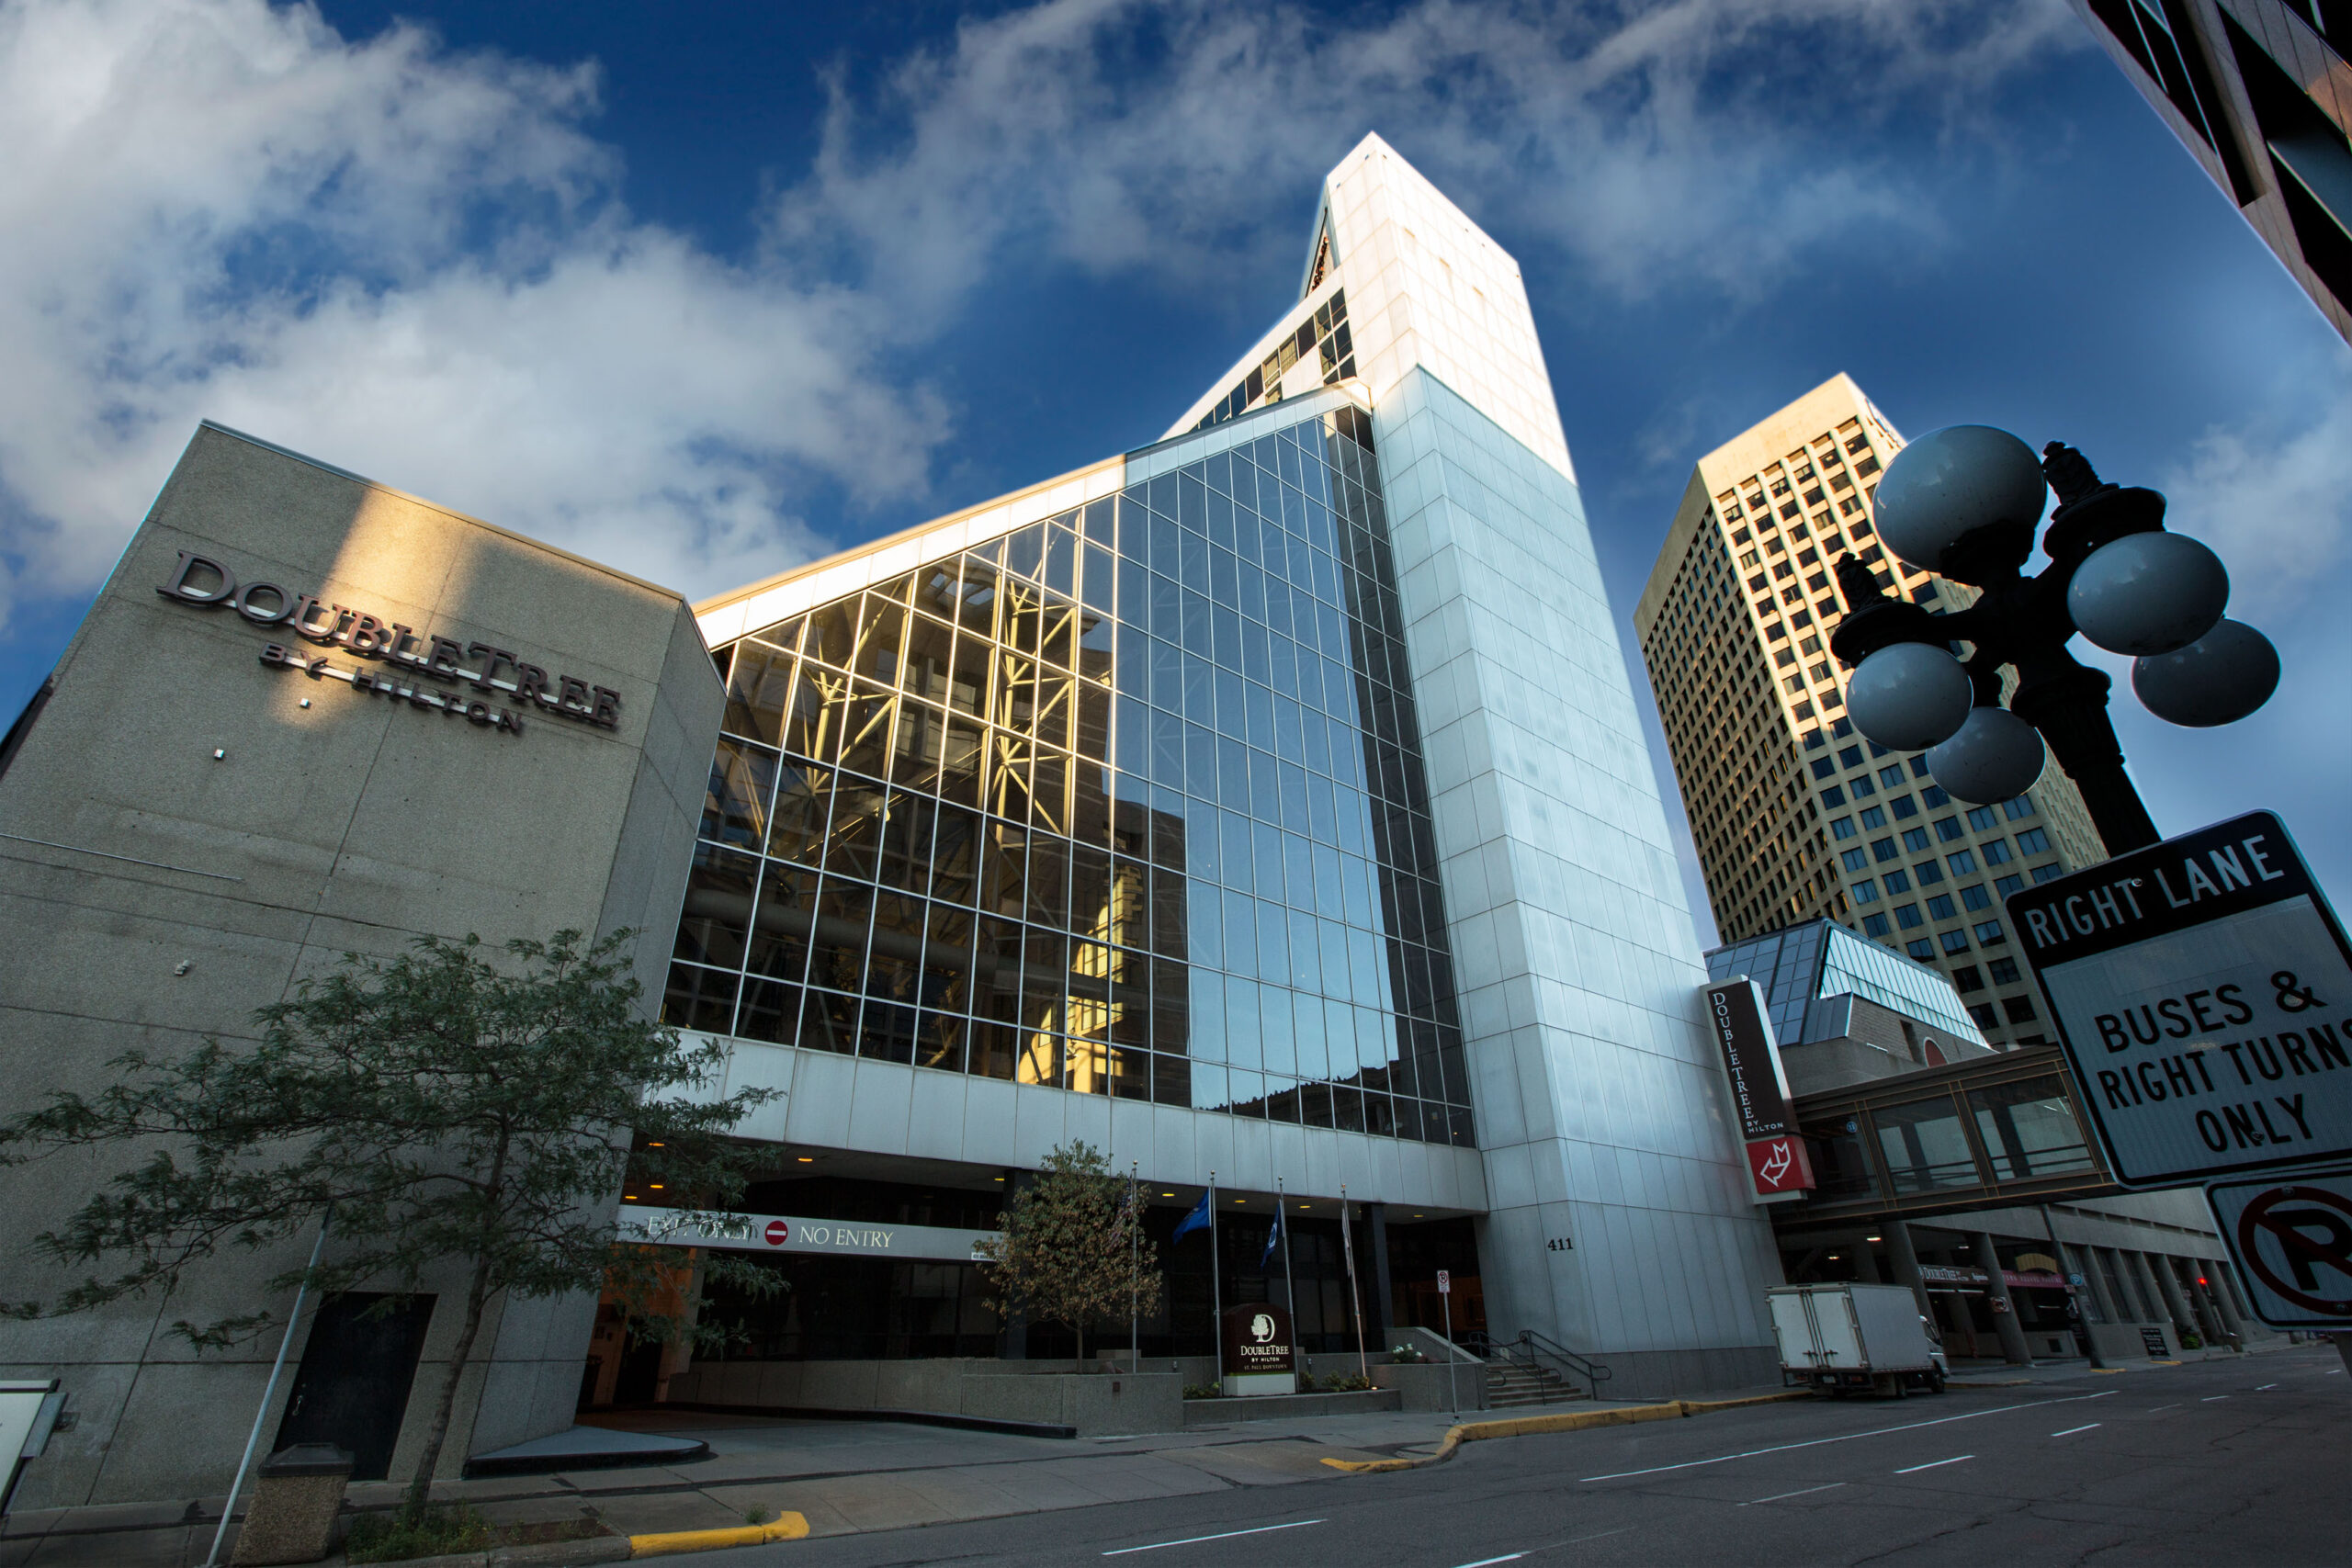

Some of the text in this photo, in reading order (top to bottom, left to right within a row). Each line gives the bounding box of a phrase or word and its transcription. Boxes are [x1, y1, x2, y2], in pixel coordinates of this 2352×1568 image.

[156, 550, 622, 728] DOUBLETREE
[258, 642, 523, 733] BY HILTON
[2024, 834, 2285, 949] RIGHT LANE
[2094, 970, 2329, 1054] BUSES &
[1713, 992, 1754, 1119] DOUBLETREE
[2097, 1050, 2215, 1111] RIGHT
[1747, 1120, 1758, 1128] BY
[1747, 1122, 1784, 1134] HILTON
[2195, 1093, 2313, 1153] ONLY
[799, 1226, 830, 1245] NO
[834, 1228, 894, 1248] ENTRY
[1547, 1237, 1574, 1251] 411
[1240, 1345, 1289, 1356] DOUBLETREE
